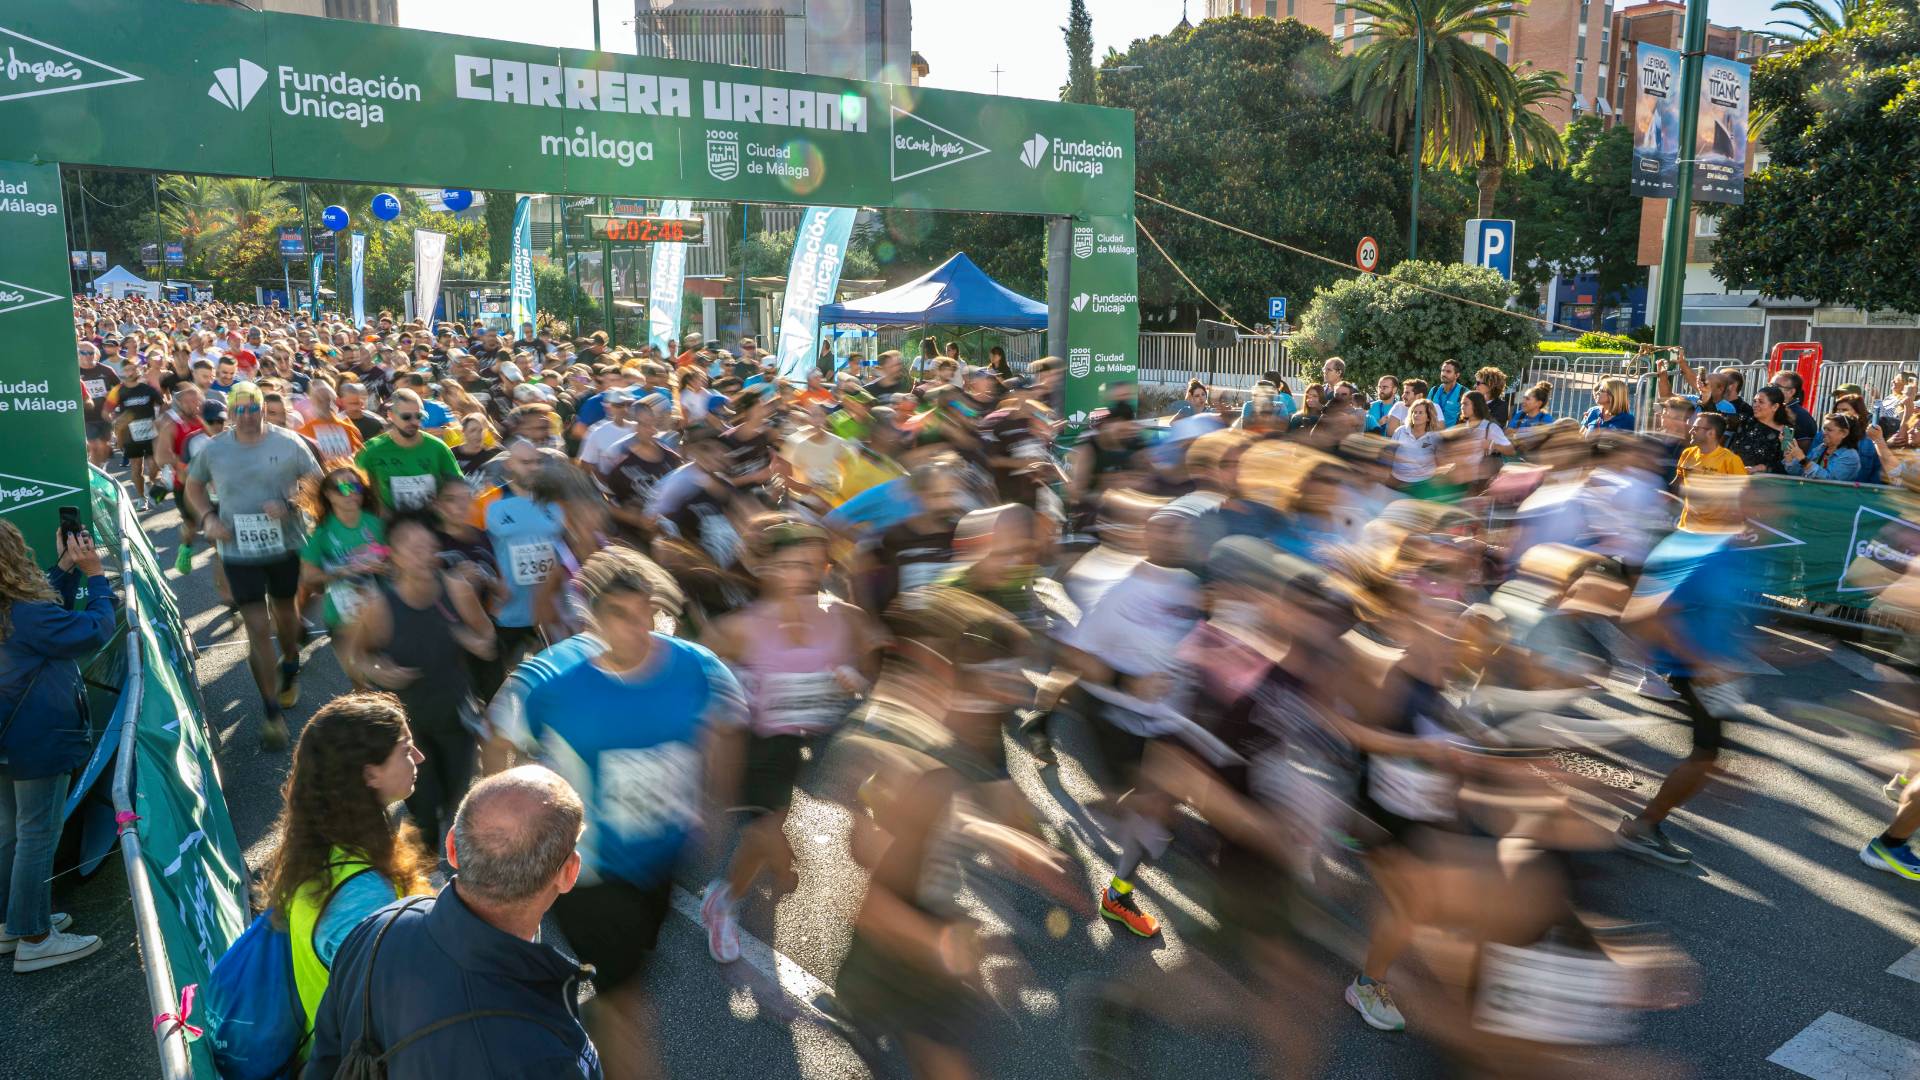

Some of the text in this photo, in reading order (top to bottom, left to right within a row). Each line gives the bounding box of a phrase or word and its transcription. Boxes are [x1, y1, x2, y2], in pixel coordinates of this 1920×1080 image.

[7, 47, 82, 83] Inglés
[278, 65, 421, 102] Fundación
[1643, 67, 1671, 90] TITANIC
[1709, 78, 1741, 101] TITANIC
[454, 54, 868, 133] CARRERA URBANA
[280, 91, 384, 128] Unicaja
[746, 142, 791, 158] Ciudad
[895, 134, 964, 158] El Corte Inglés
[1053, 138, 1122, 159] Fundación
[746, 161, 810, 179] de Málaga
[1053, 154, 1103, 179] Unicaja
[607, 218, 684, 241] 0:02:46
[1097, 234, 1124, 243] Ciudad
[1097, 245, 1135, 255] de Málaga
[1362, 249, 1375, 261] 20
[1484, 228, 1505, 269] P
[513, 227, 524, 299] Fundación
[795, 210, 829, 310] Fundación
[520, 248, 532, 299] Unicaja
[1092, 293, 1137, 304] Fundación
[1092, 303, 1125, 315] Unicaja
[1272, 300, 1282, 316] P
[1095, 353, 1124, 362] Ciudad
[1095, 363, 1136, 374] de Málaga
[14, 397, 78, 413] Málaga
[240, 528, 278, 542] 5565
